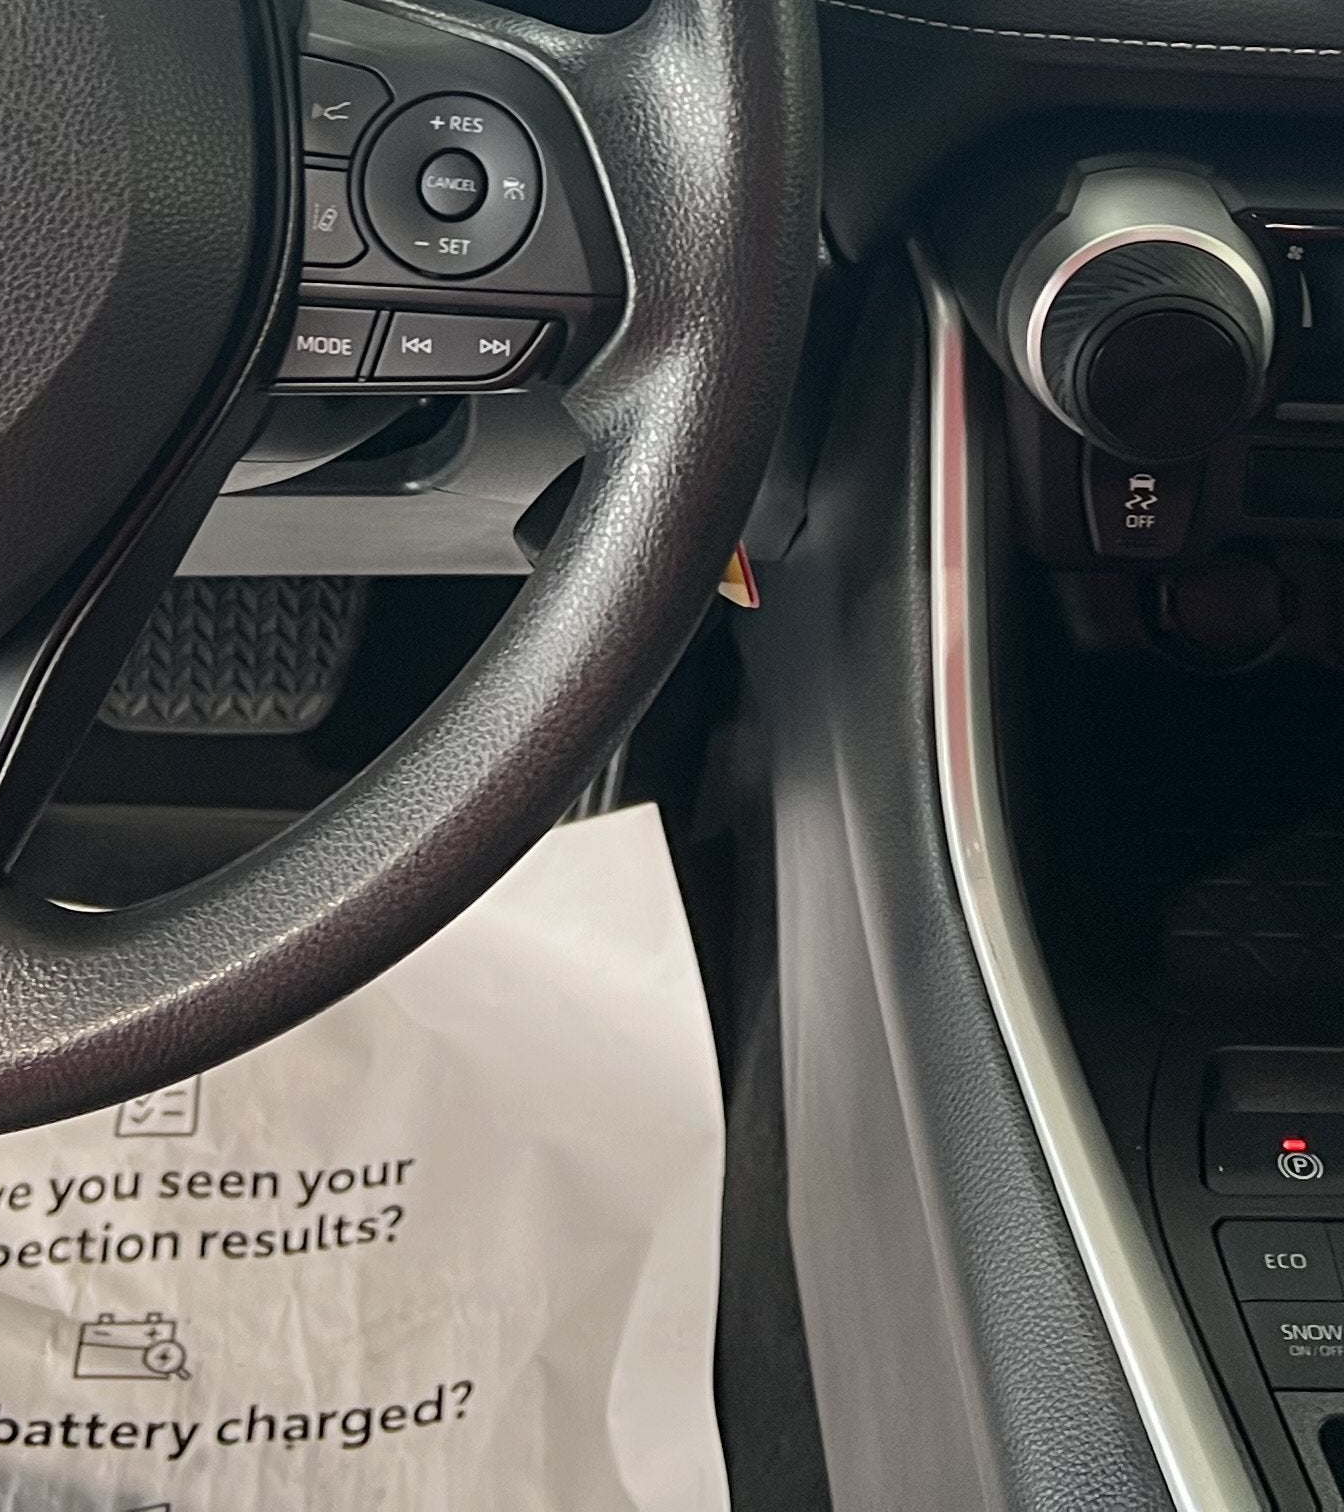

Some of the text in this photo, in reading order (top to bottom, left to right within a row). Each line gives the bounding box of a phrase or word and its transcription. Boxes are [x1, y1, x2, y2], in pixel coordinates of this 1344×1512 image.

[449, 117, 484, 134] RES
[425, 175, 477, 193] CANCEL
[438, 238, 471, 256] SET
[296, 336, 353, 356] MODE
[1126, 514, 1155, 528] OFF
[47, 1172, 142, 1217] you
[158, 1169, 279, 1202] seen
[297, 1156, 415, 1209] your
[197, 1204, 406, 1262] results?
[1264, 1253, 1307, 1269] ECO
[1280, 1324, 1343, 1341] SNOW
[215, 1379, 474, 1450] charged?
